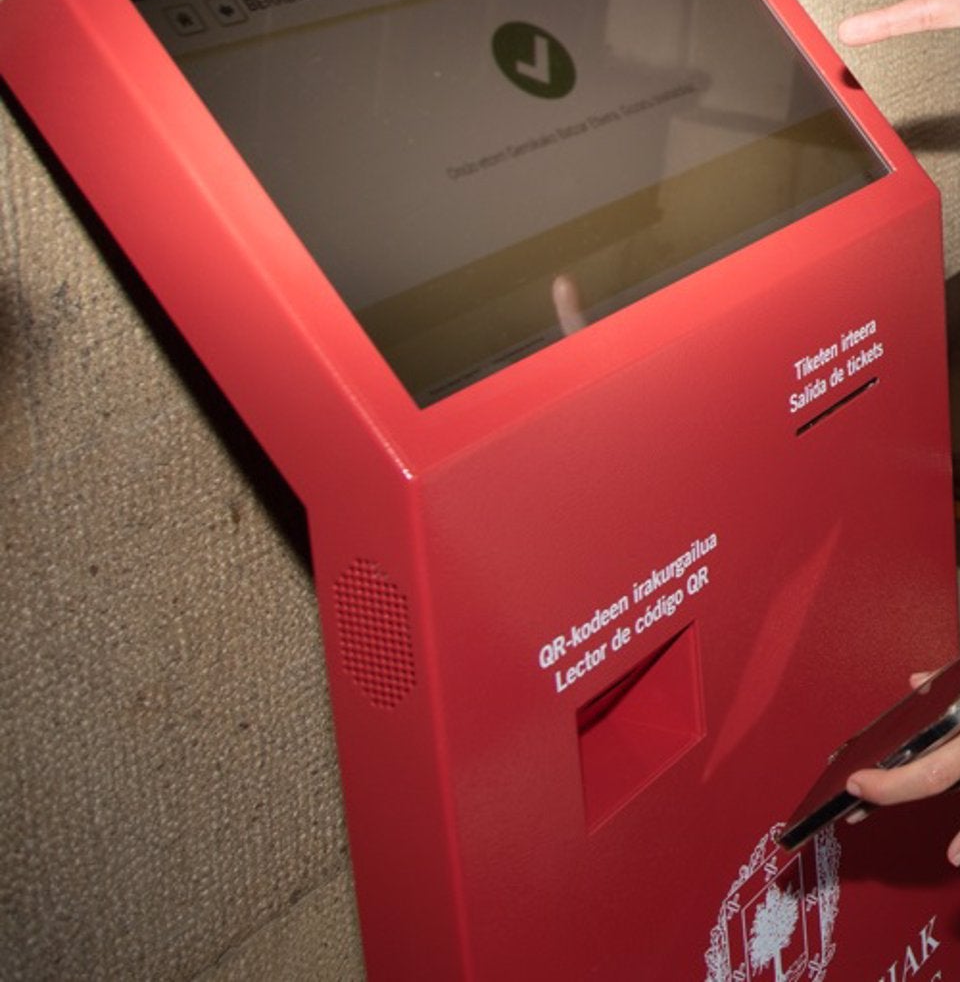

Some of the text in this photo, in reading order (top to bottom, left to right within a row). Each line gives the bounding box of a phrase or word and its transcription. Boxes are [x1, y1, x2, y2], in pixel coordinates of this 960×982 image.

[789, 342, 884, 413] Salida de tickets
[794, 319, 877, 380] Tiketen irteera
[539, 532, 718, 670] QR-kodeen irakurgailua
[555, 565, 709, 694] Lector de código QR
